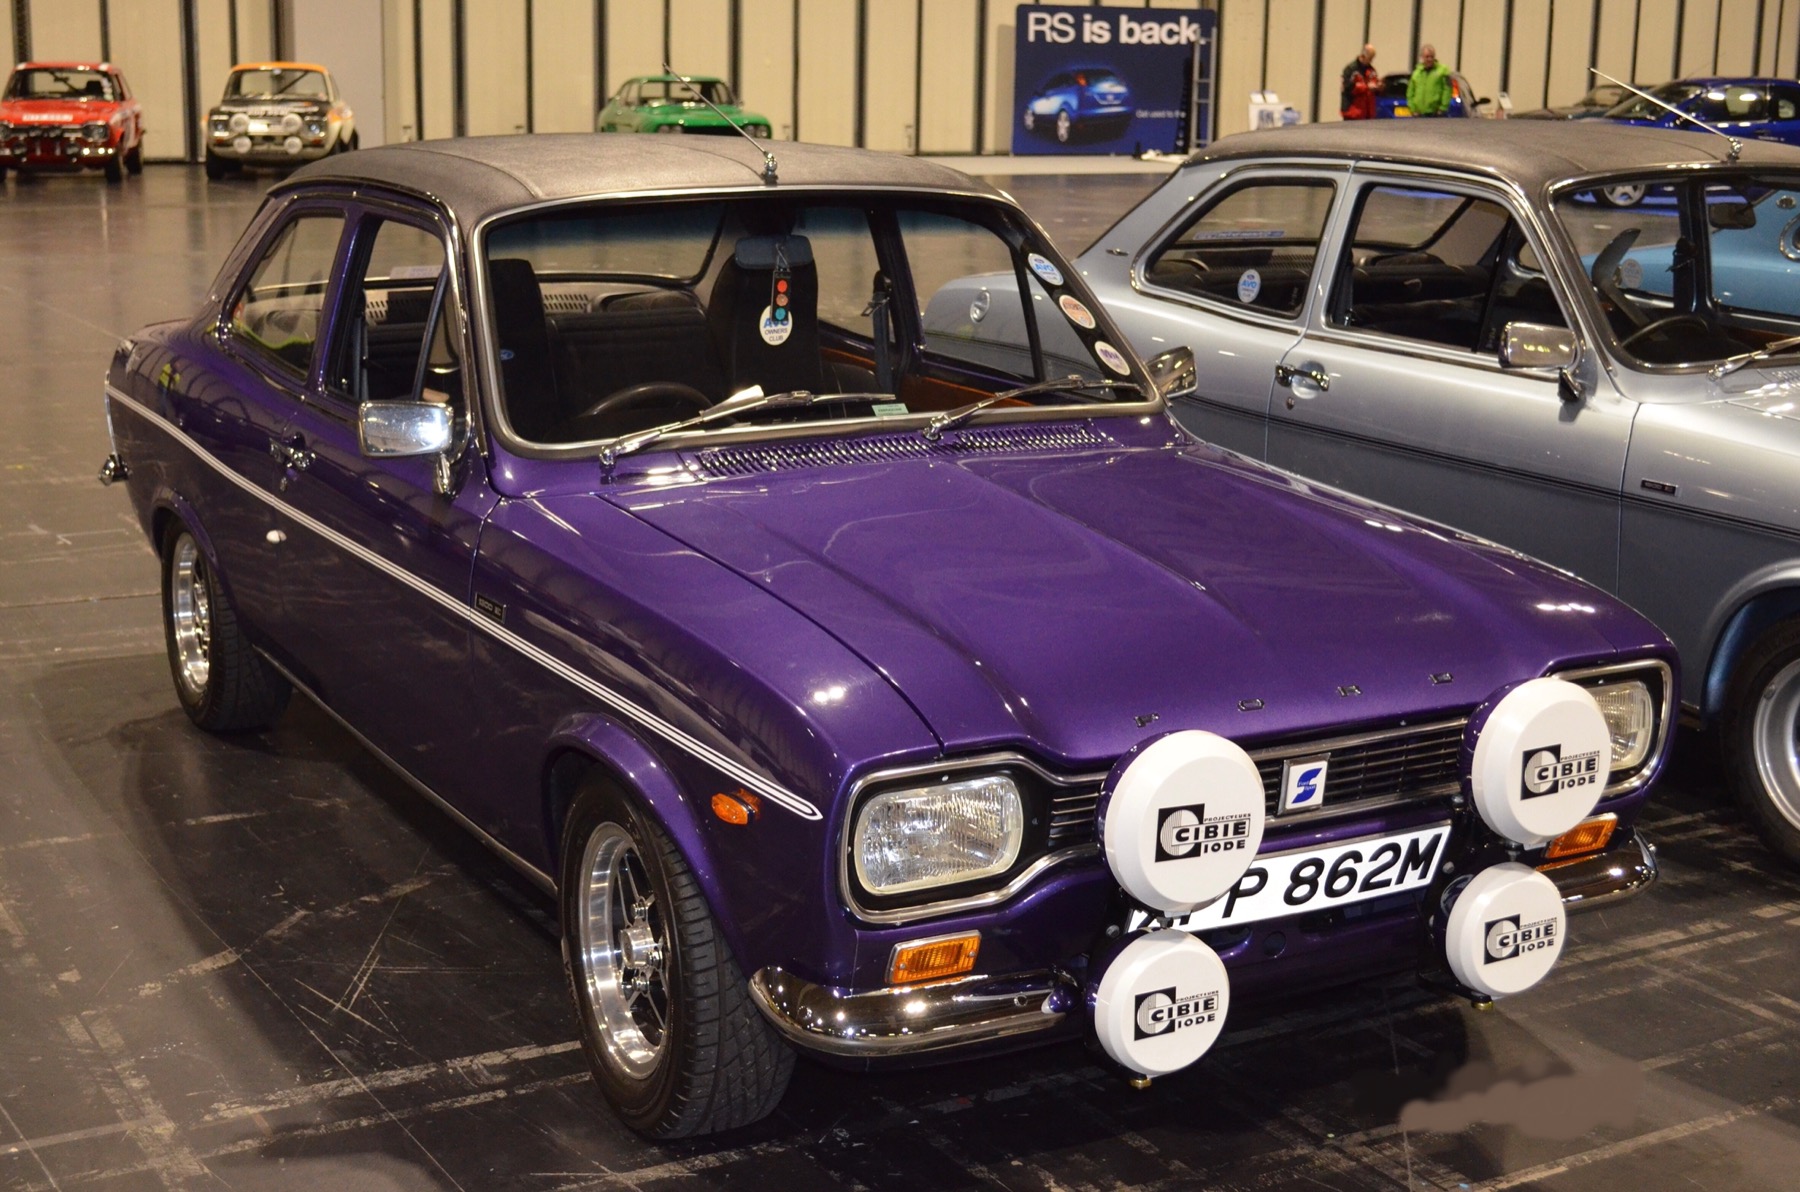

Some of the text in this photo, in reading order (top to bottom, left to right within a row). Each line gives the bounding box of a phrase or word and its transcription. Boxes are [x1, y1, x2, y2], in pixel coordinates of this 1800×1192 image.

[1028, 12, 1206, 45] RS is back.
[765, 328, 787, 336] OWNERS
[1537, 758, 1596, 780] CIBIE
[1561, 774, 1596, 790] IODE
[1175, 821, 1246, 842] CIBIE
[1203, 839, 1246, 853] IODE
[1283, 833, 1443, 906] 862M
[1498, 924, 1554, 947] CIBIE
[1521, 938, 1554, 953] IODE
[1151, 998, 1215, 1022] CIBIE
[1178, 1013, 1215, 1029] IODE
